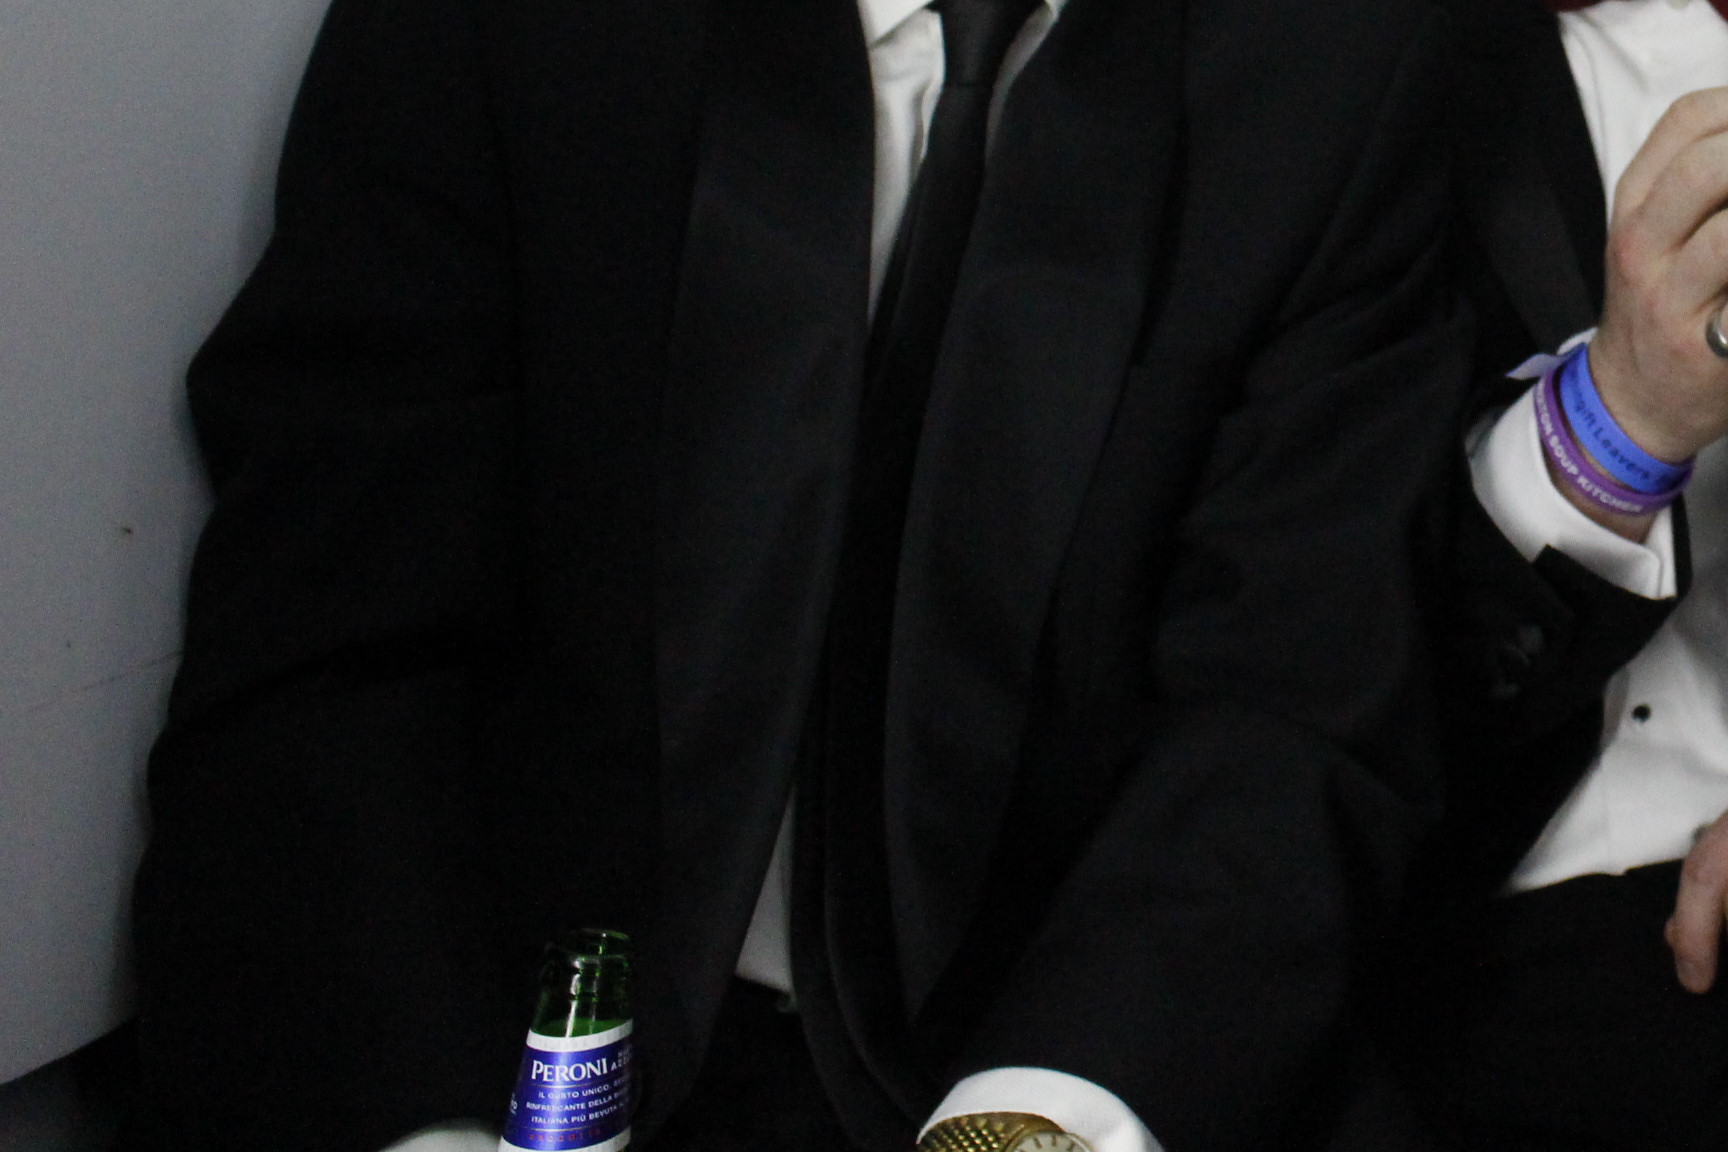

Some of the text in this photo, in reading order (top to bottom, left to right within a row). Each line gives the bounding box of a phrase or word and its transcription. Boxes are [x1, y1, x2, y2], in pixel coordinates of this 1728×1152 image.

[1550, 434, 1578, 475] SOUP
[531, 1058, 608, 1083] PERONI
[588, 1094, 613, 1108] DELLA
[531, 1115, 569, 1125] ITALIANA
[588, 1105, 617, 1120] BEVUTA
